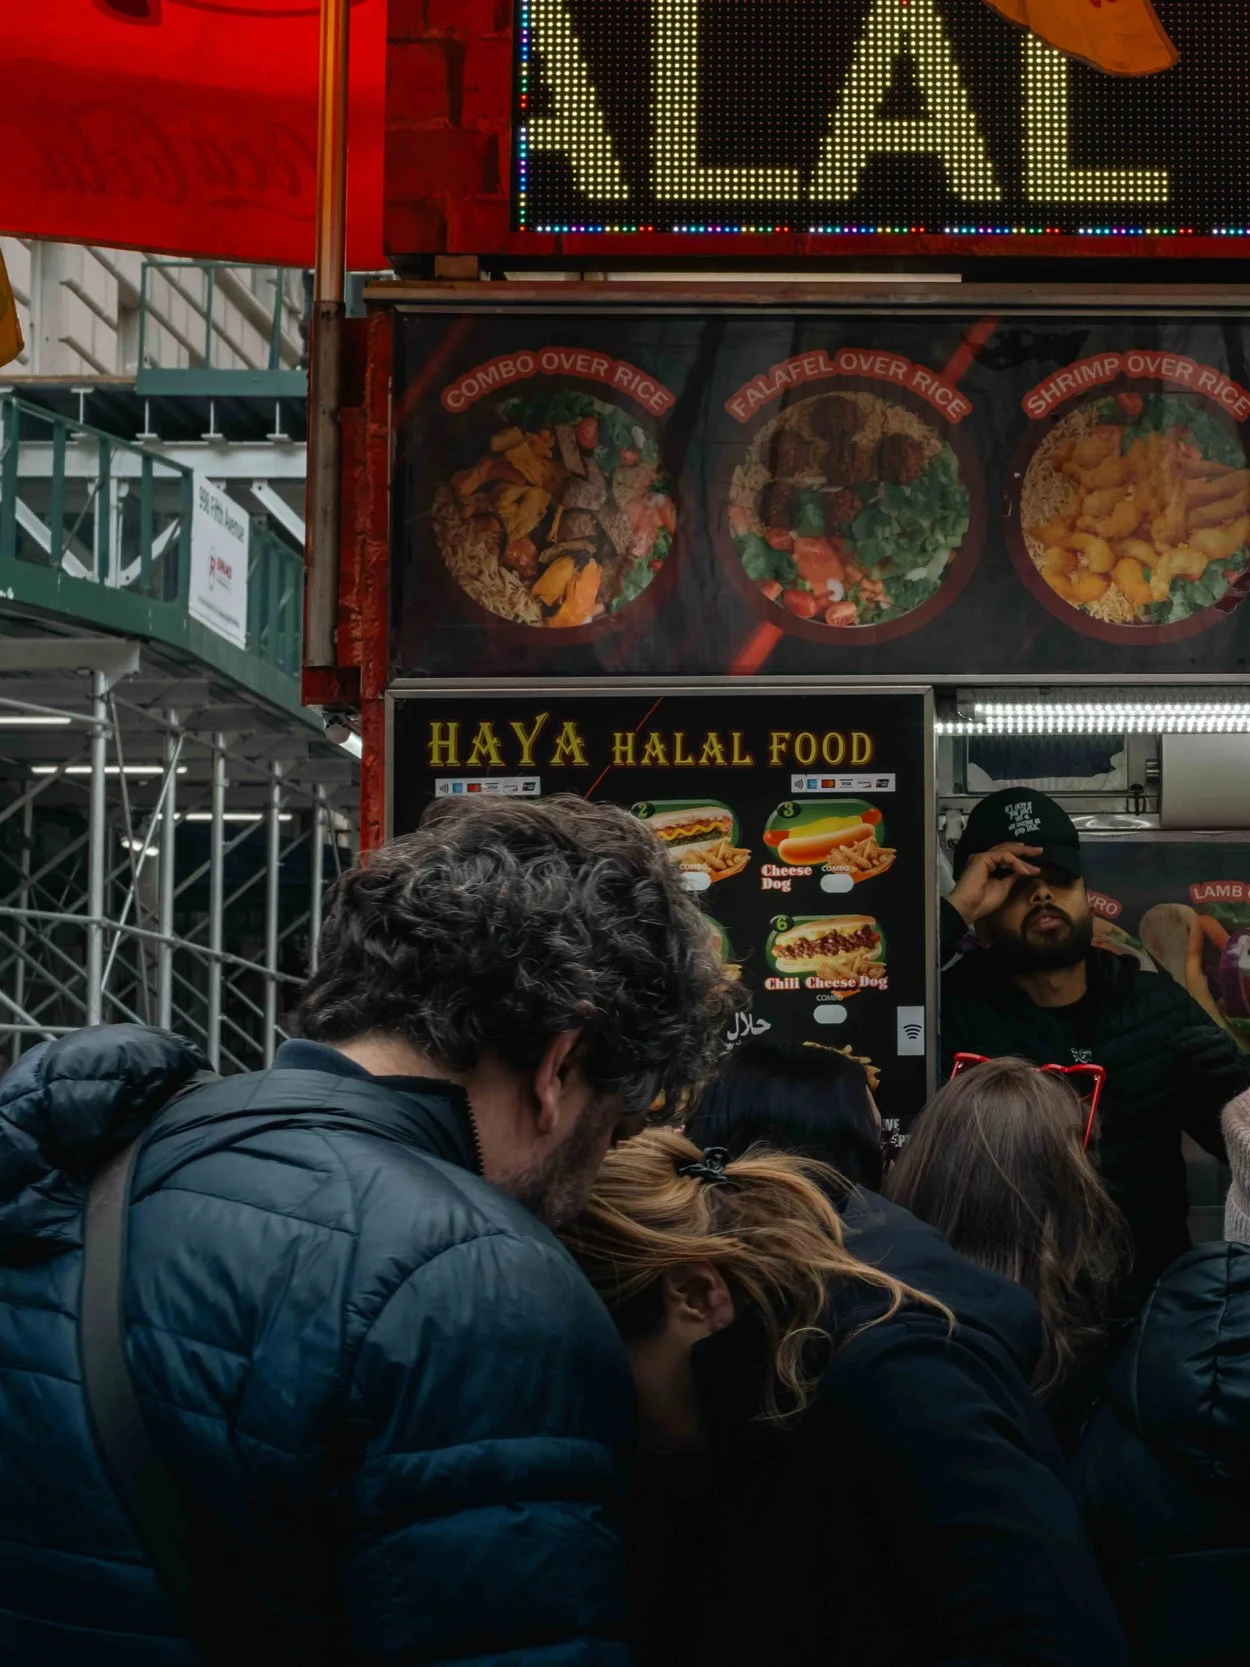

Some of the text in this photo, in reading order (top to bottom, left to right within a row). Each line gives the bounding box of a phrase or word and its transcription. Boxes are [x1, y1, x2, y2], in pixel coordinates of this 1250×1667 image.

[446, 352, 669, 411] COMBO OVER RICE
[730, 353, 967, 418] FALAFEL OVER RICE
[1026, 357, 1120, 414] SHRIMP
[1127, 355, 1193, 380] OVER
[427, 711, 874, 767] HAYA HALAL FOOD
[638, 801, 649, 818] 2
[784, 801, 795, 818] 3
[760, 863, 813, 877] Cheese
[821, 864, 850, 872] COMBO
[760, 876, 792, 893] Dog
[1194, 885, 1242, 900] LAMB
[776, 916, 788, 931] 6
[764, 976, 889, 991] Chili Cheese Dog
